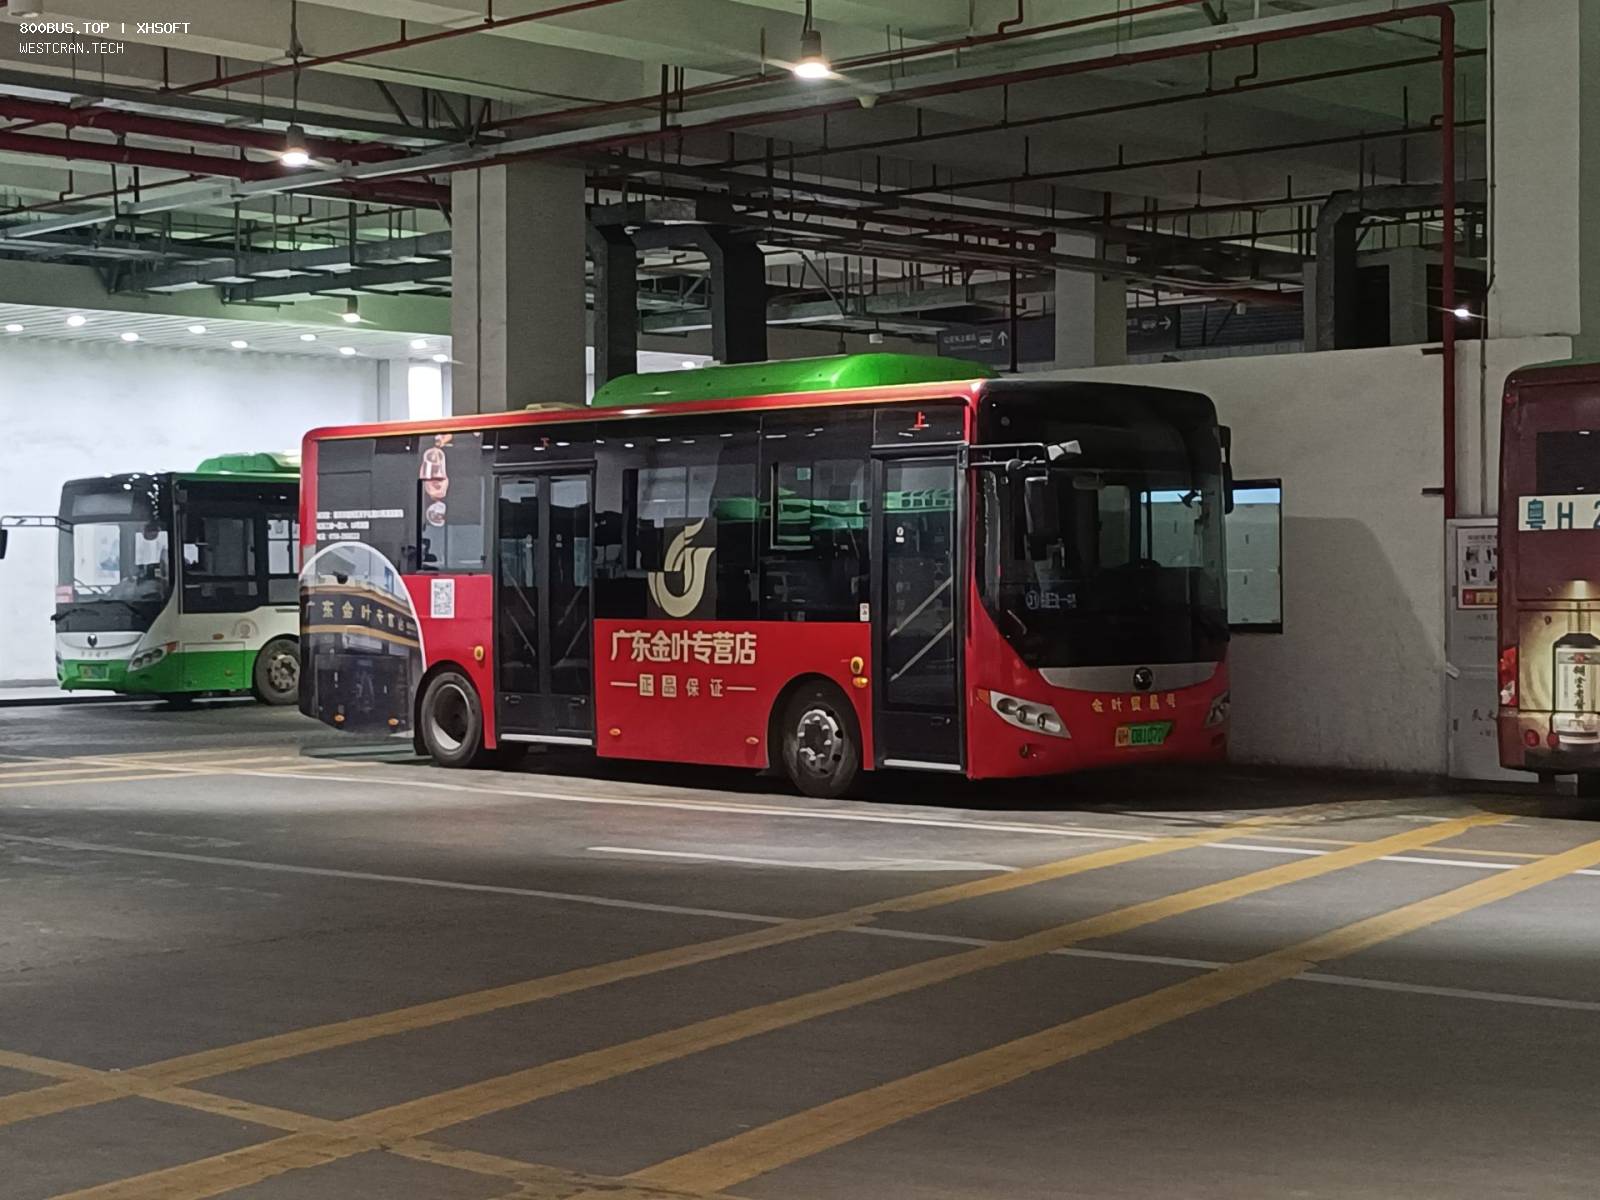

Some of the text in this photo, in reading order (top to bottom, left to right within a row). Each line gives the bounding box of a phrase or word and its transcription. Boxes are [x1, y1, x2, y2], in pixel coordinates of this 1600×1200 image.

[611, 629, 757, 665] 广东金叶专营店
[639, 673, 724, 698] 正品保证
